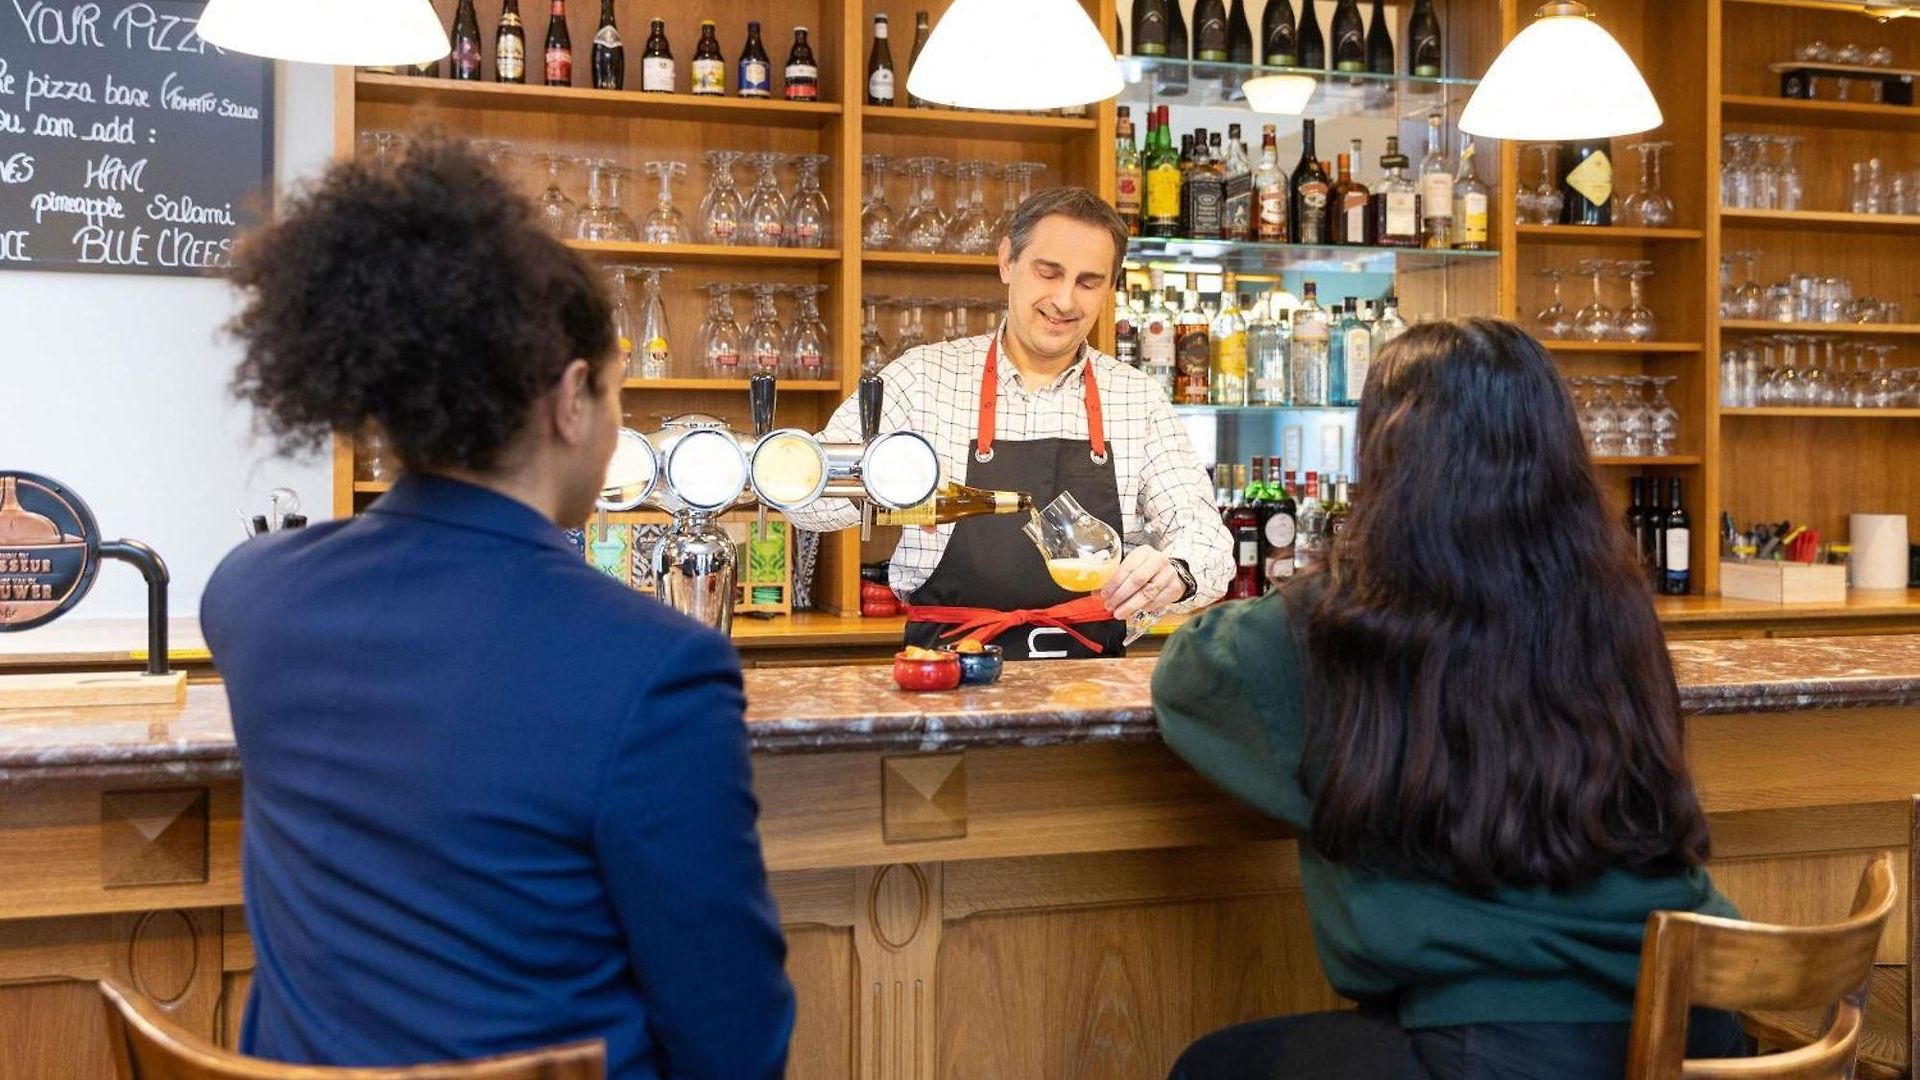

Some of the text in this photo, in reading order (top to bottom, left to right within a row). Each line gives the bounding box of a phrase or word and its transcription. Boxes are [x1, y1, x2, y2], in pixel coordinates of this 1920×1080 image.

[12, 0, 104, 47] YOUR
[25, 70, 96, 112] pizza
[106, 73, 151, 108] base
[33, 112, 77, 139] can
[84, 154, 149, 192] HAM
[31, 191, 236, 226] pineapple Salami
[72, 225, 151, 266] BLUE
